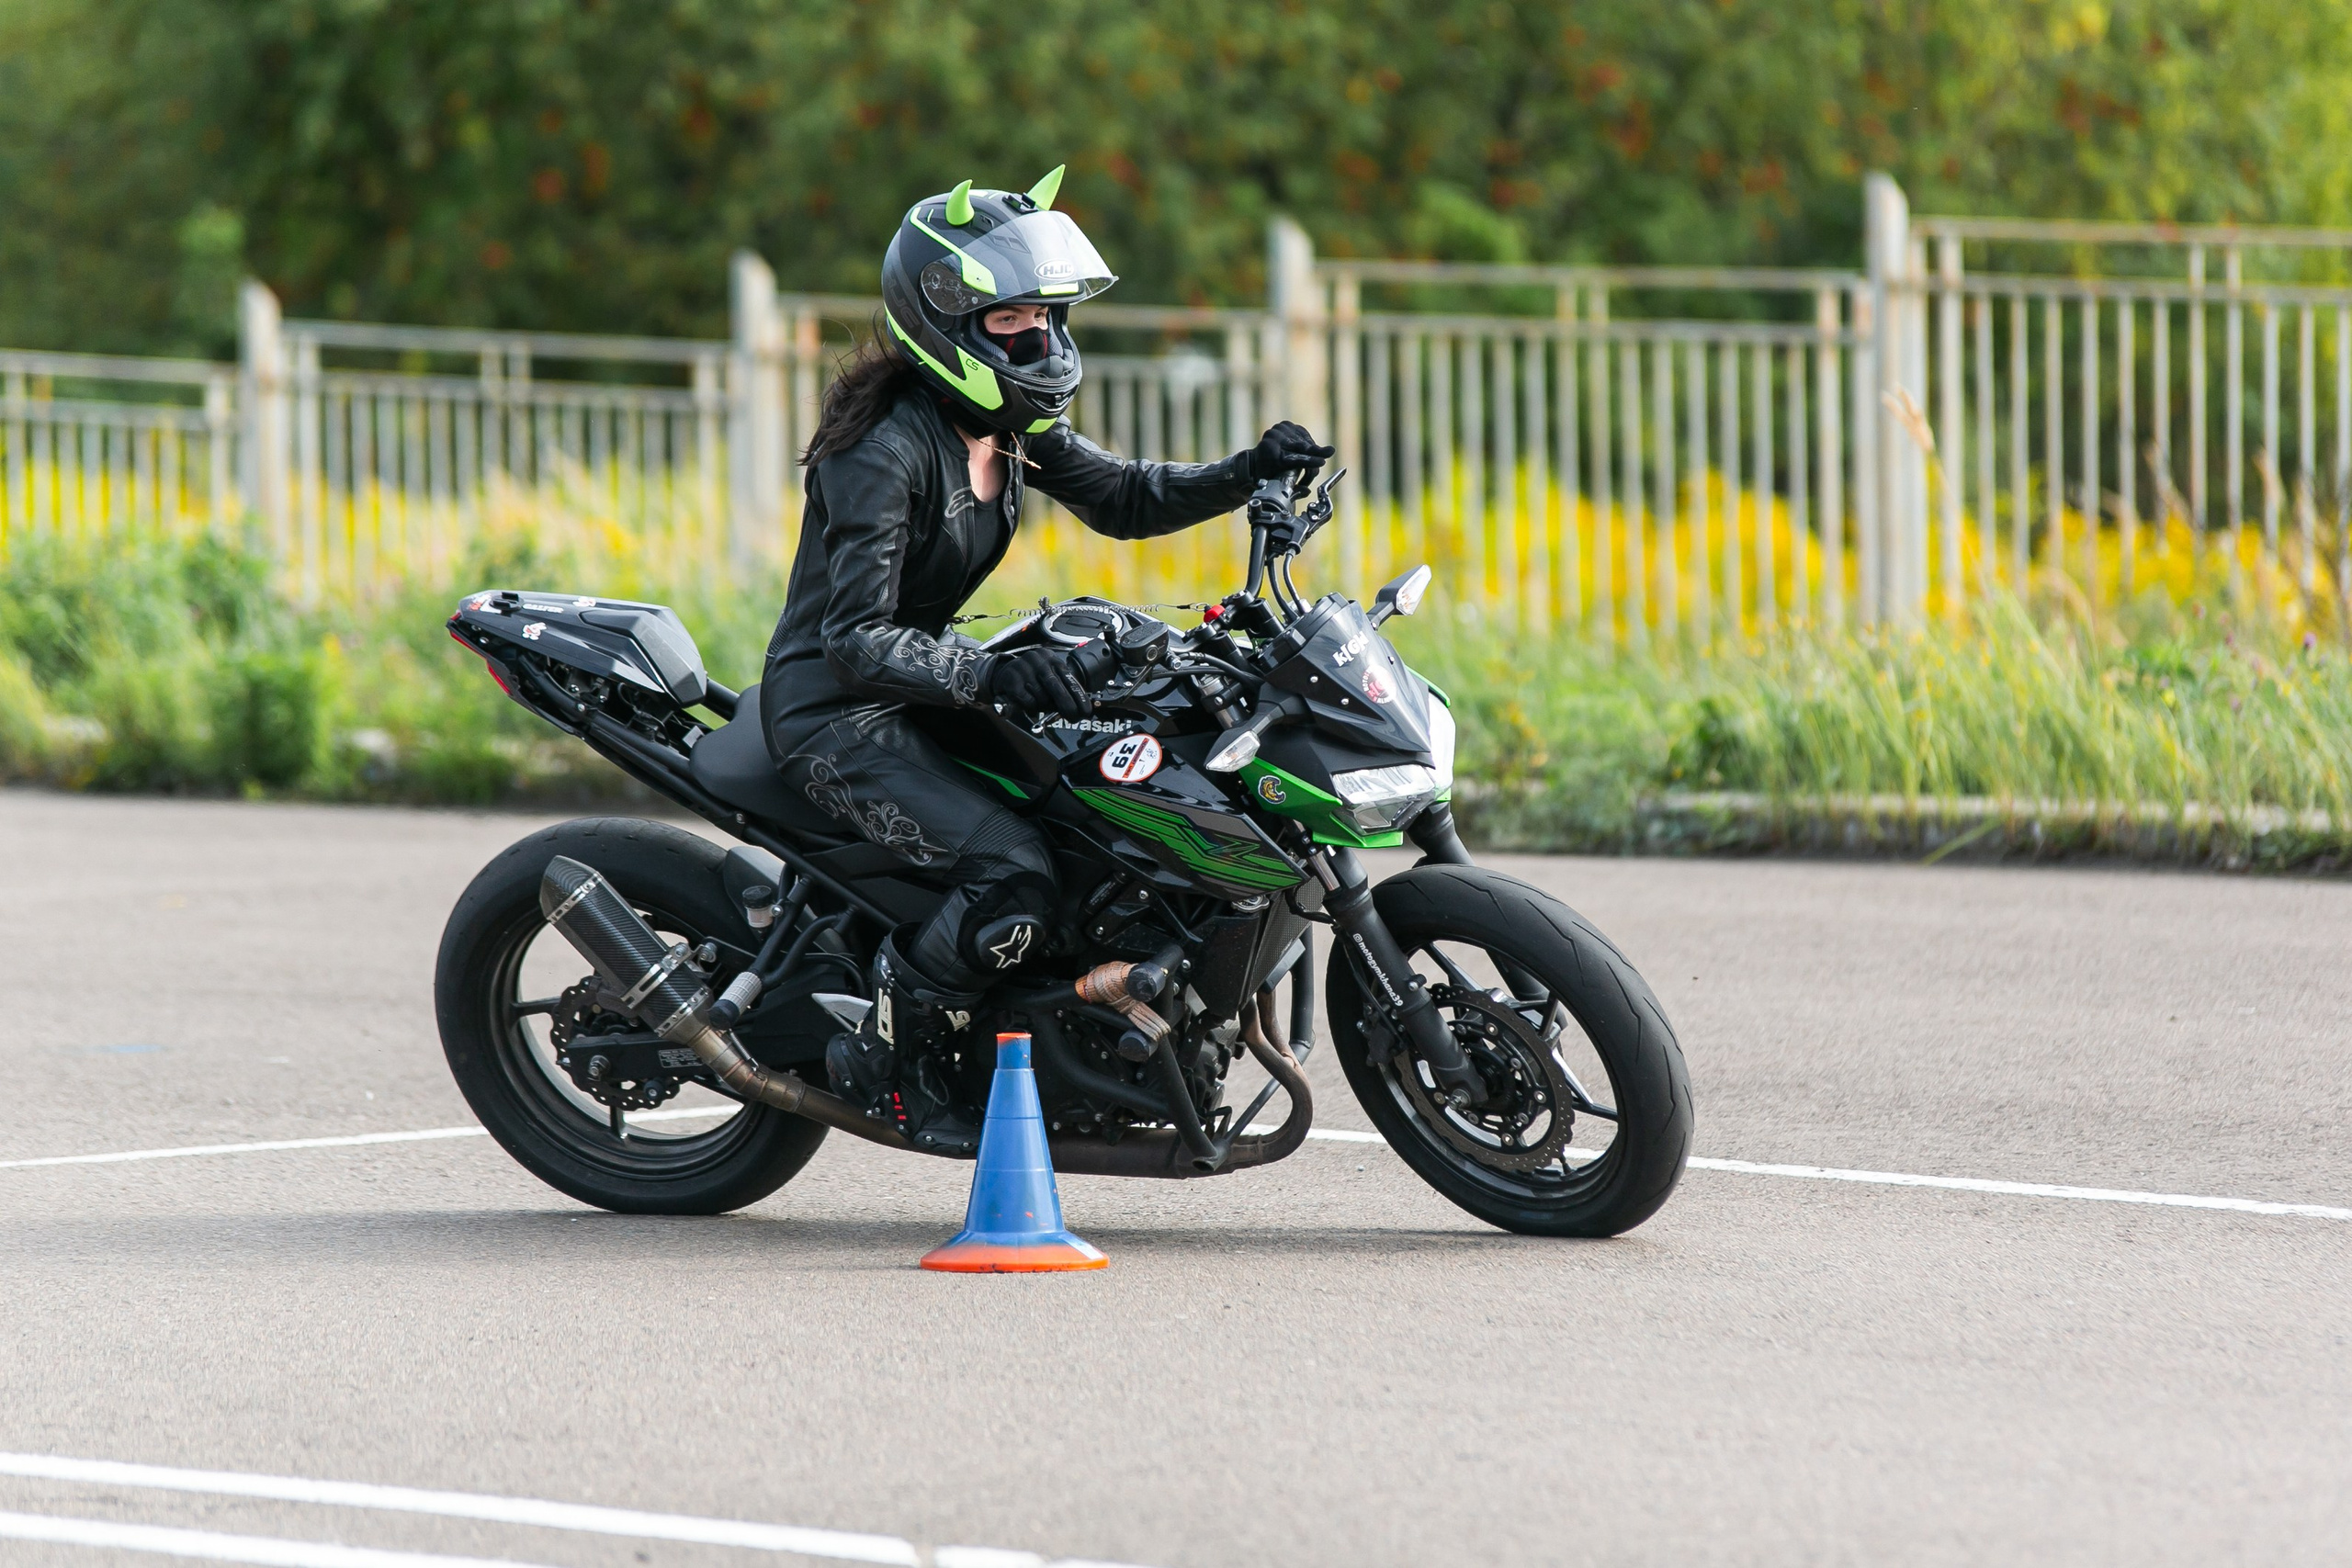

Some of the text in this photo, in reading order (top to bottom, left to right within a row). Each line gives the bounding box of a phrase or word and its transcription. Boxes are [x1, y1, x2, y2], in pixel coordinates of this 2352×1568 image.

[1043, 264, 1072, 276] HJC
[965, 358, 979, 371] CS
[1111, 742, 1138, 769] 39
[1358, 942, 1404, 1007] motogymkhana39
